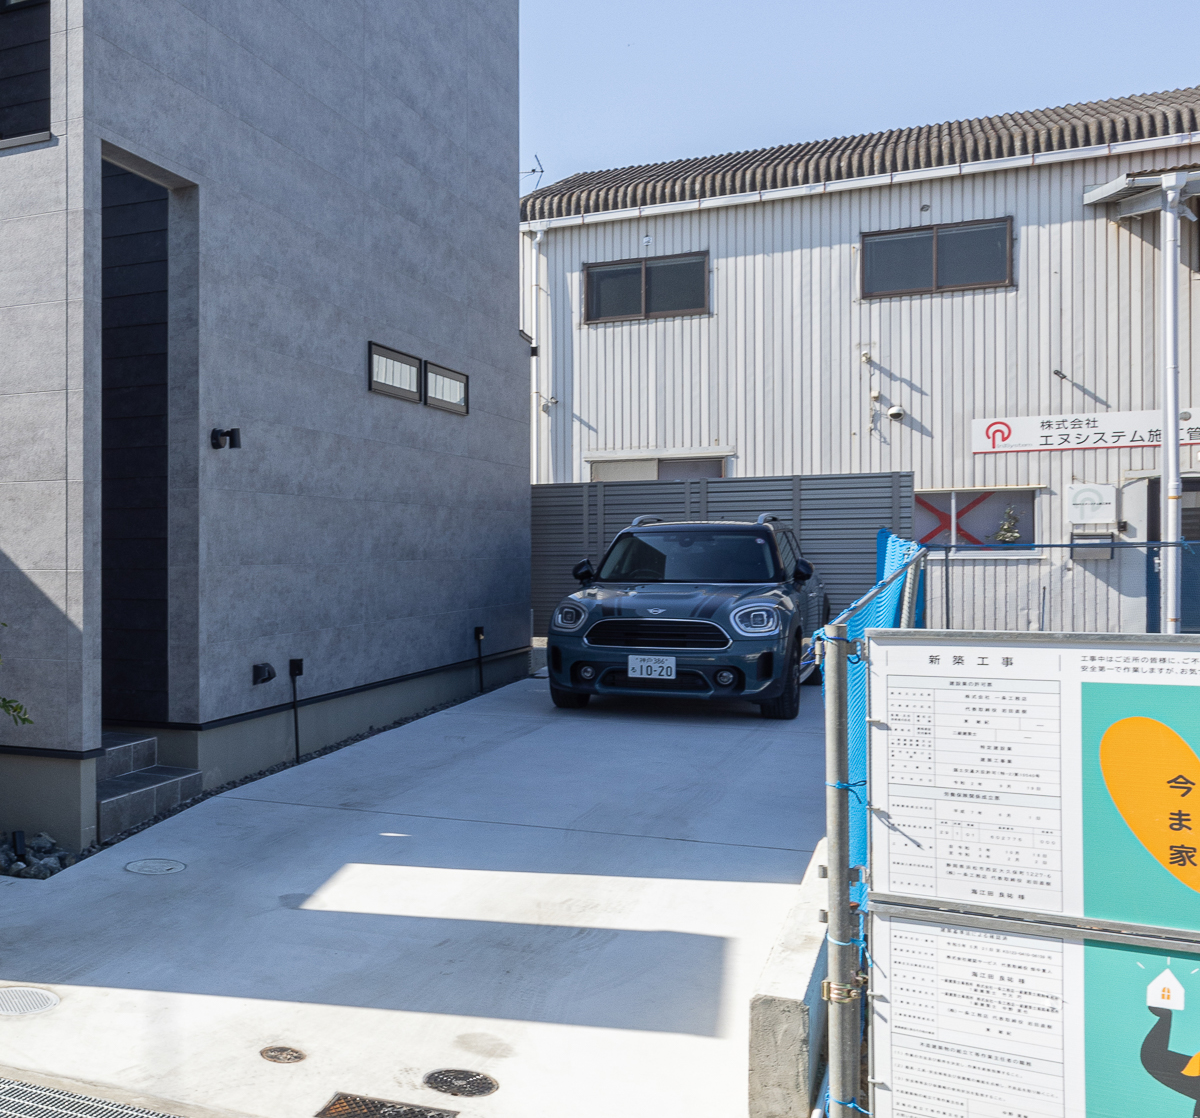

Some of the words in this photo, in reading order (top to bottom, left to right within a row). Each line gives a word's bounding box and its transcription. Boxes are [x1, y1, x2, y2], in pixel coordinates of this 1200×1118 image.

[1040, 417, 1098, 430] 株式会社
[928, 654, 1013, 667] 新築工事
[640, 665, 673, 677] 10-20
[1081, 665, 1200, 675] 安全第一で作業しますが、お気
